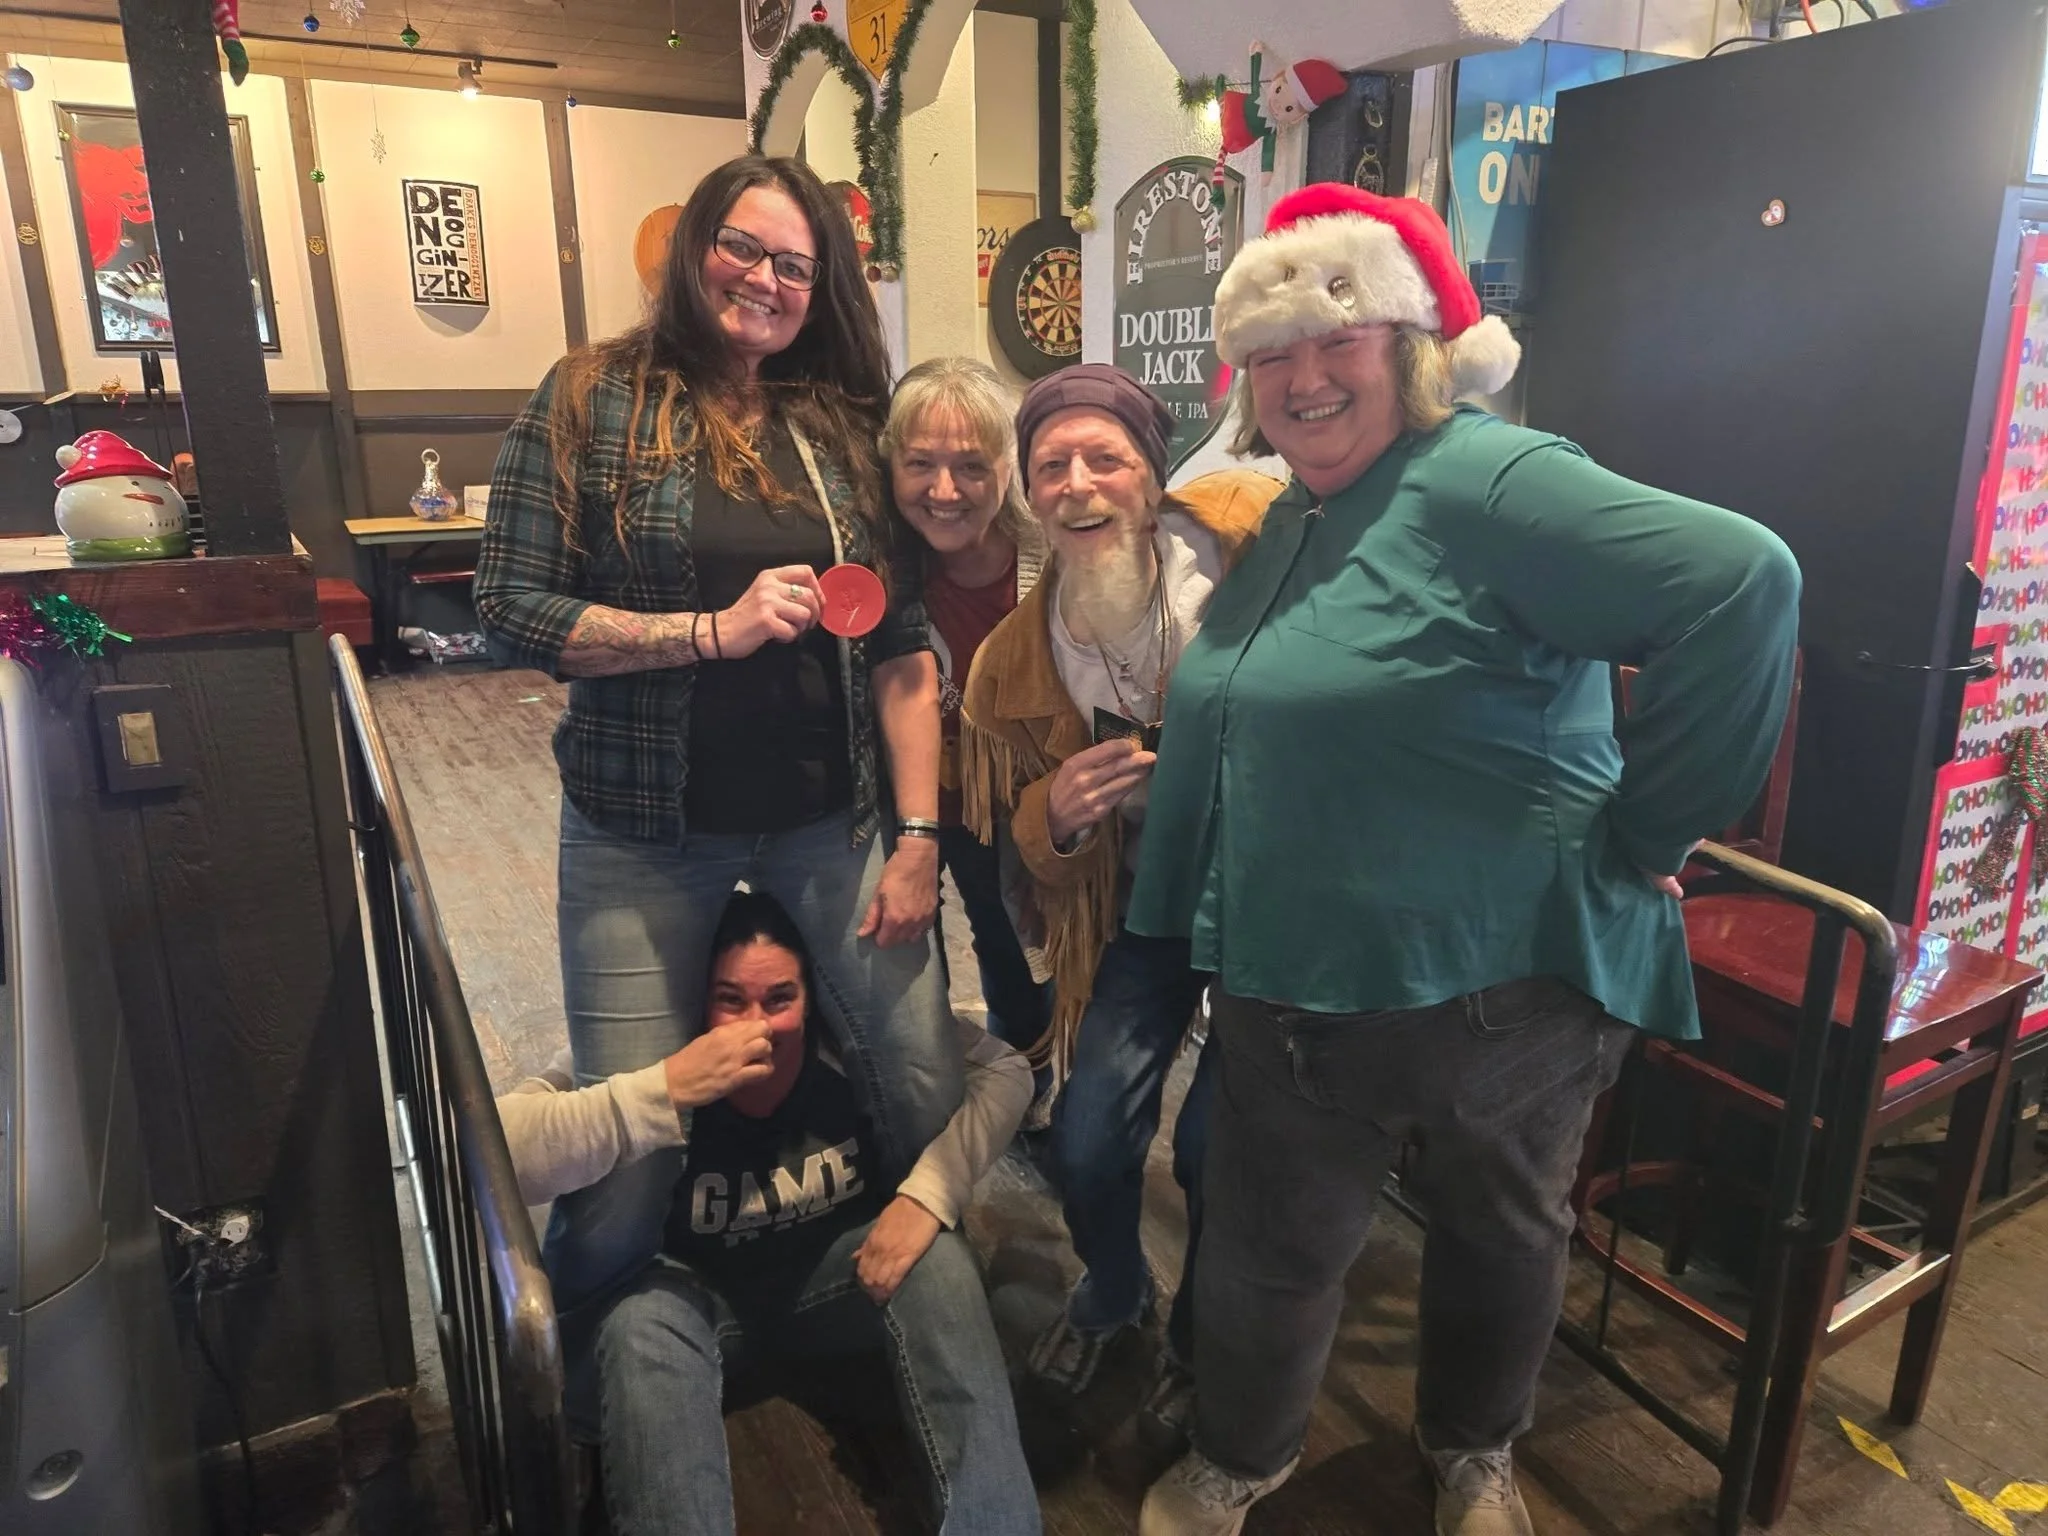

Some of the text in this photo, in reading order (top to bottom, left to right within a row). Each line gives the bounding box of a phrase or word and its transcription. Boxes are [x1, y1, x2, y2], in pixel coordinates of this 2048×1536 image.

[869, 11, 887, 64] 31
[1483, 101, 1555, 145] BAR
[409, 185, 464, 218] DE
[1126, 170, 1223, 285] FIRESTONE
[418, 268, 473, 299] IZER
[1139, 349, 1205, 386] JACK
[1188, 402, 1208, 419] IPA
[691, 1137, 864, 1235] GAME
